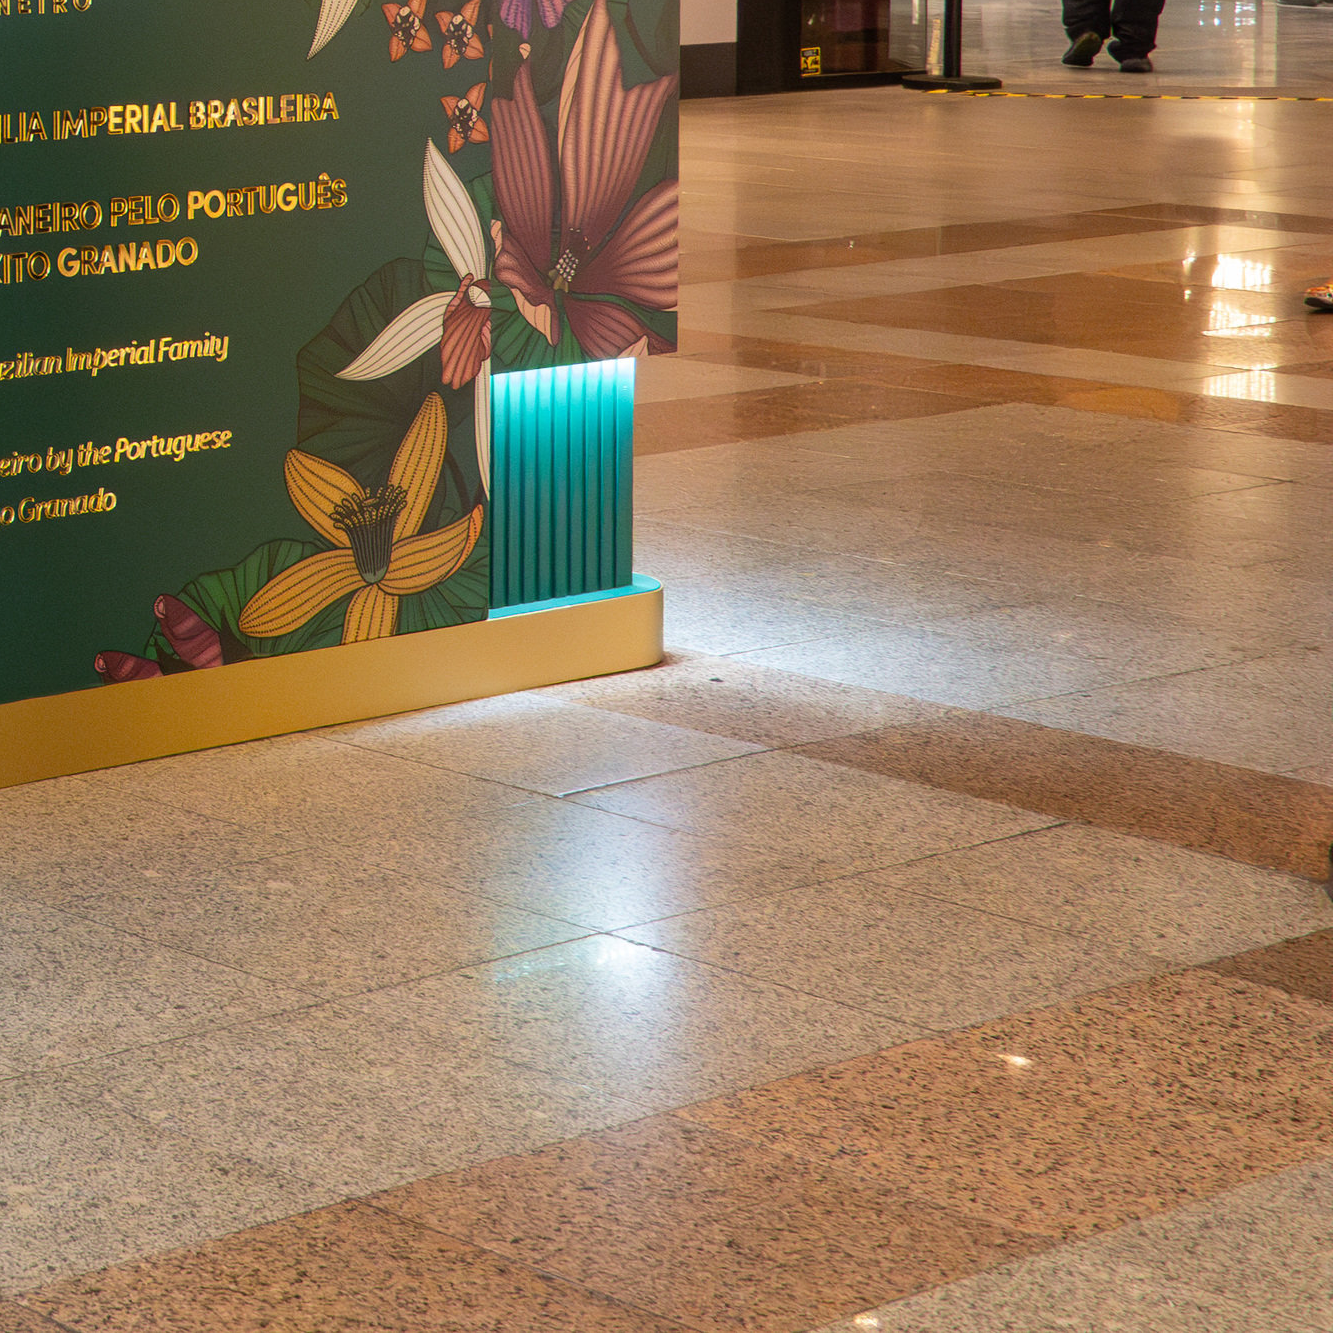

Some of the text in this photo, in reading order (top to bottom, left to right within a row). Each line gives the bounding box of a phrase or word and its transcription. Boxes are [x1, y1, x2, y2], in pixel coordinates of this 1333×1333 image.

[52, 101, 184, 141] IMPERIAL
[189, 91, 340, 130] BRASILEIRA
[110, 192, 180, 228] PELO
[187, 171, 348, 221] PORTUGUÊS
[57, 236, 199, 278] GRANADO
[65, 339, 156, 377] Imperial
[157, 332, 229, 362] Family
[45, 447, 73, 475] by
[77, 441, 111, 467] the
[113, 429, 232, 463] Portuguese
[18, 487, 117, 523] Granado
